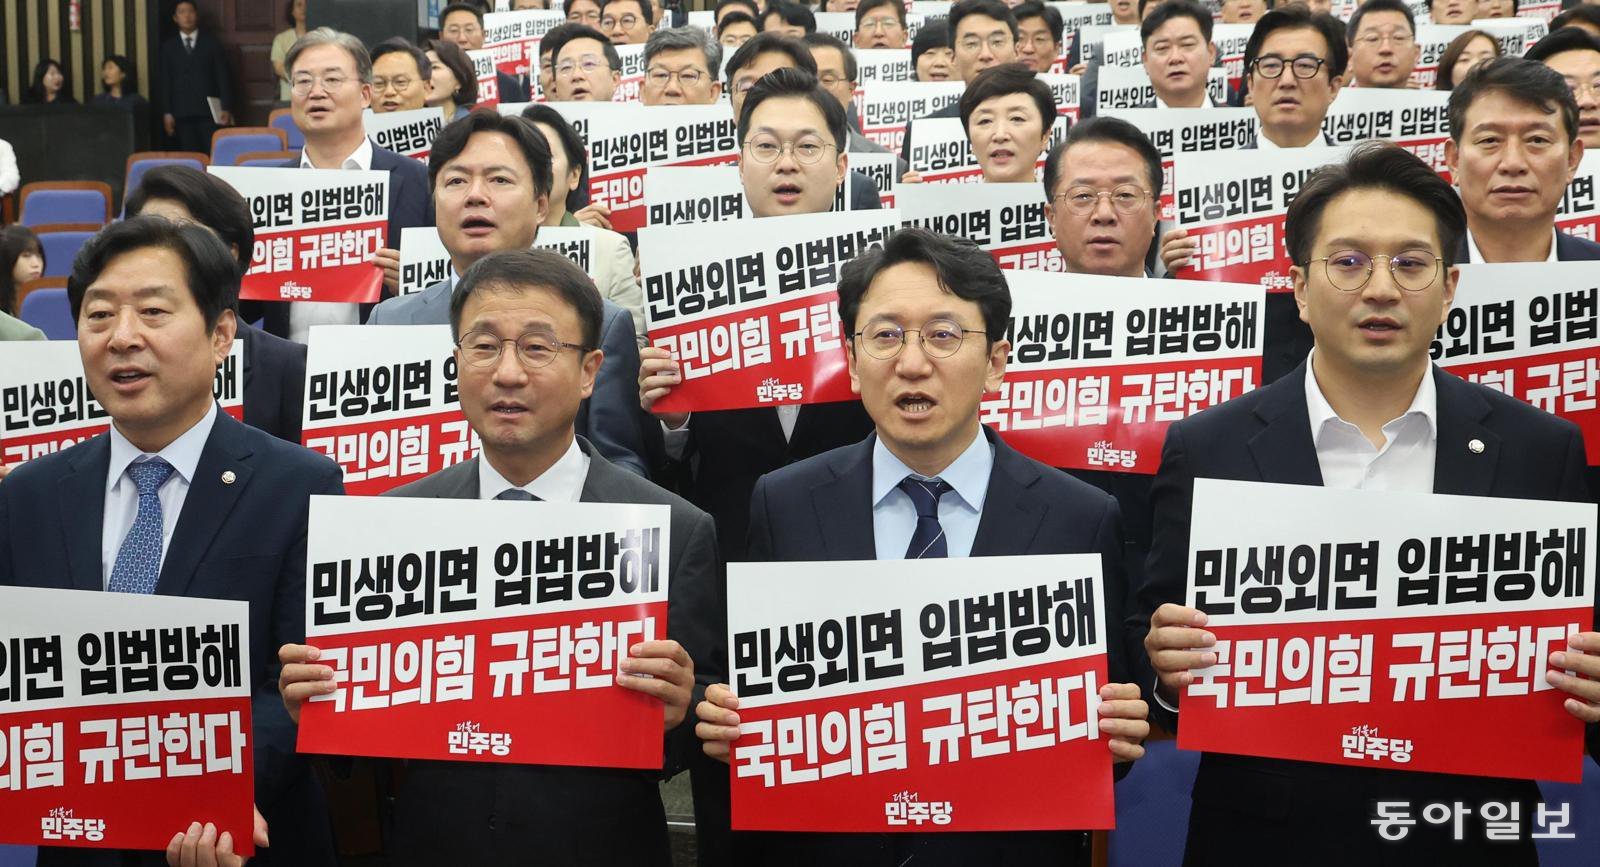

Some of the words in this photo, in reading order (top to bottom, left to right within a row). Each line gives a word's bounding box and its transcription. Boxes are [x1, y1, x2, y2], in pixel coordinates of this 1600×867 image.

[882, 61, 917, 81] 입법
[592, 129, 668, 171] 민생외면
[676, 119, 737, 157] 입법방
[1181, 118, 1255, 151] 입법방해
[246, 193, 293, 228] 외면
[301, 183, 384, 224] 입법방해
[590, 174, 647, 211] 국민의
[1179, 175, 1273, 224] 민생외면
[1000, 201, 1050, 242] 입법
[246, 237, 293, 276] 의힘
[300, 227, 385, 270] 규탄한다
[645, 252, 767, 322] 민생외면
[780, 300, 843, 360] 규탄
[1126, 301, 1257, 356] 입법방해
[1430, 300, 1514, 360] 외면
[309, 360, 431, 421] 민생외면
[756, 382, 803, 402] 민주당
[980, 376, 1110, 432] 국민의힘
[1087, 447, 1137, 468] 민주당
[313, 546, 478, 626] 민생외면
[494, 527, 661, 608] 입법방해
[1194, 540, 1379, 616] 민생외면
[1397, 527, 1586, 607] 입법방해
[78, 623, 242, 696] 입법방해
[734, 608, 904, 698] 민생외면
[920, 577, 1097, 672] 입법방해
[309, 634, 475, 713] 국민의힘
[1187, 634, 1374, 709] 국민의힘
[79, 710, 247, 785] 규탄한다
[448, 731, 512, 756] 민주당
[735, 701, 908, 788] 국민의힘
[922, 670, 1102, 766] 규탄한다
[1342, 734, 1413, 763] 민주당
[41, 817, 106, 841] 민주당
[885, 801, 953, 826] 민주당
